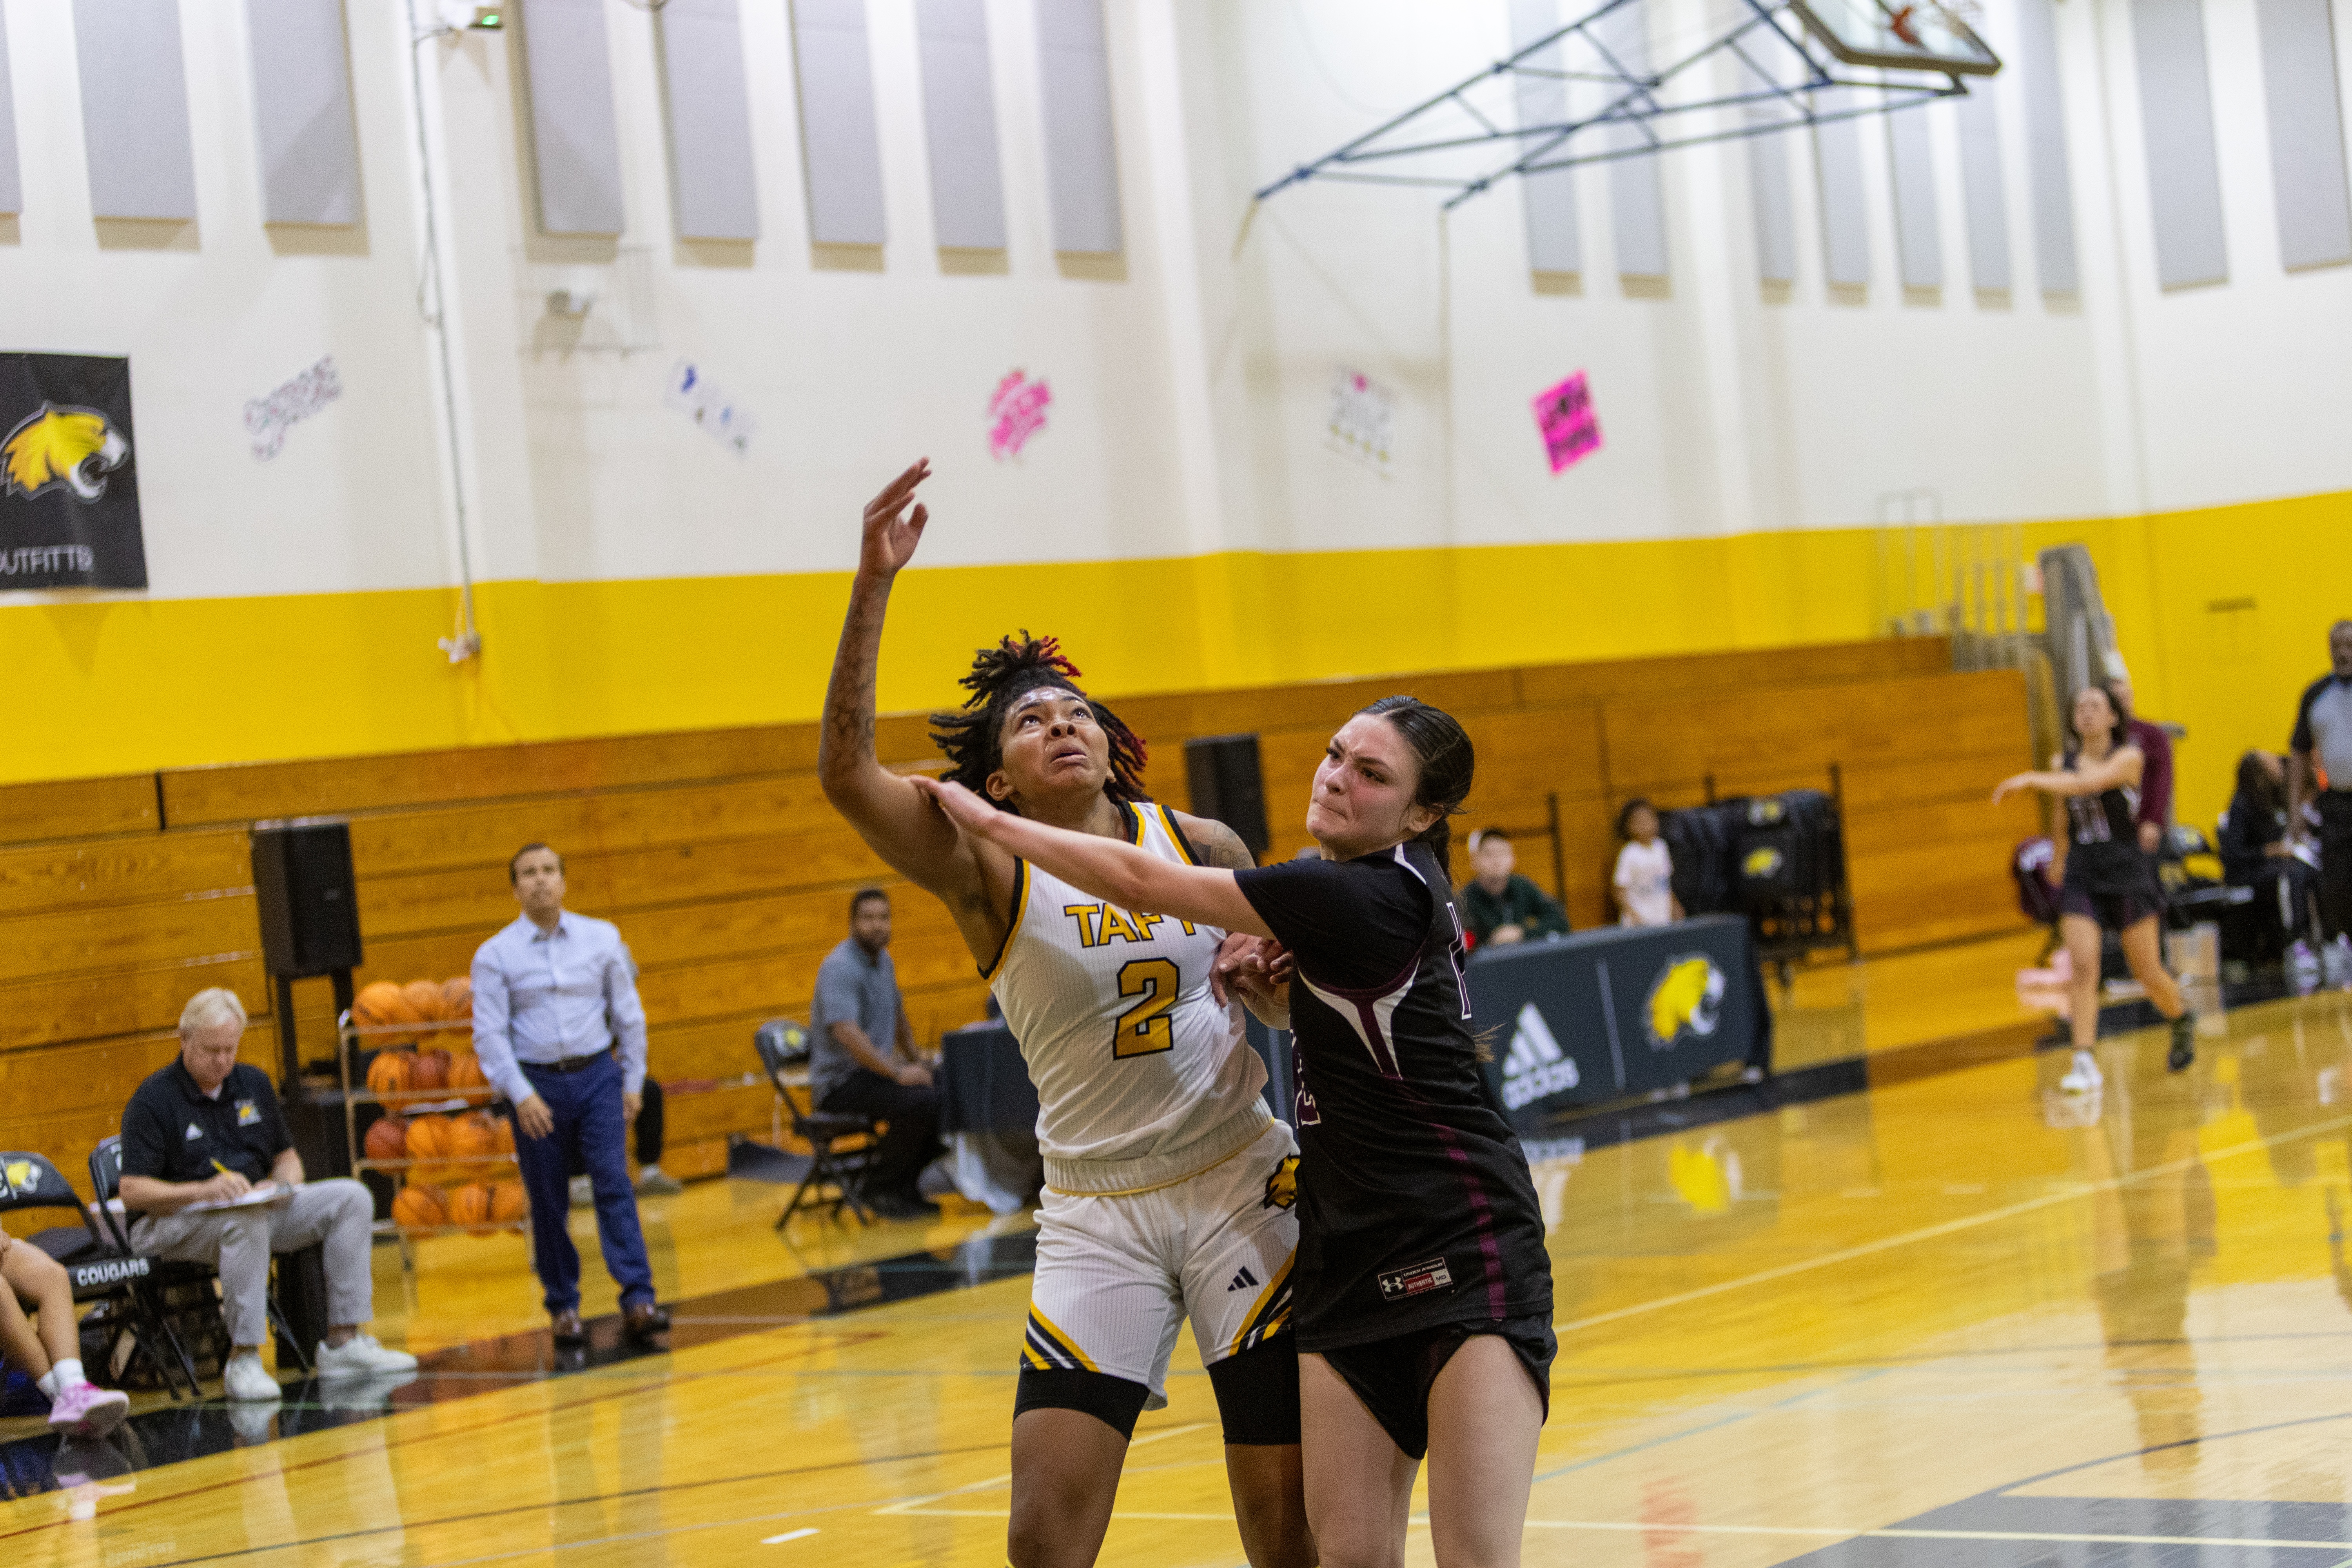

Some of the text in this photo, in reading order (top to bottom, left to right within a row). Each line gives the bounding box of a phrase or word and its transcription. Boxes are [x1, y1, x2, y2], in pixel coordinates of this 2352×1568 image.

[1112, 957, 1180, 1060] 2
[77, 1257, 151, 1287] COUGARS
[1408, 1278, 1433, 1289] AUTHENTIC
